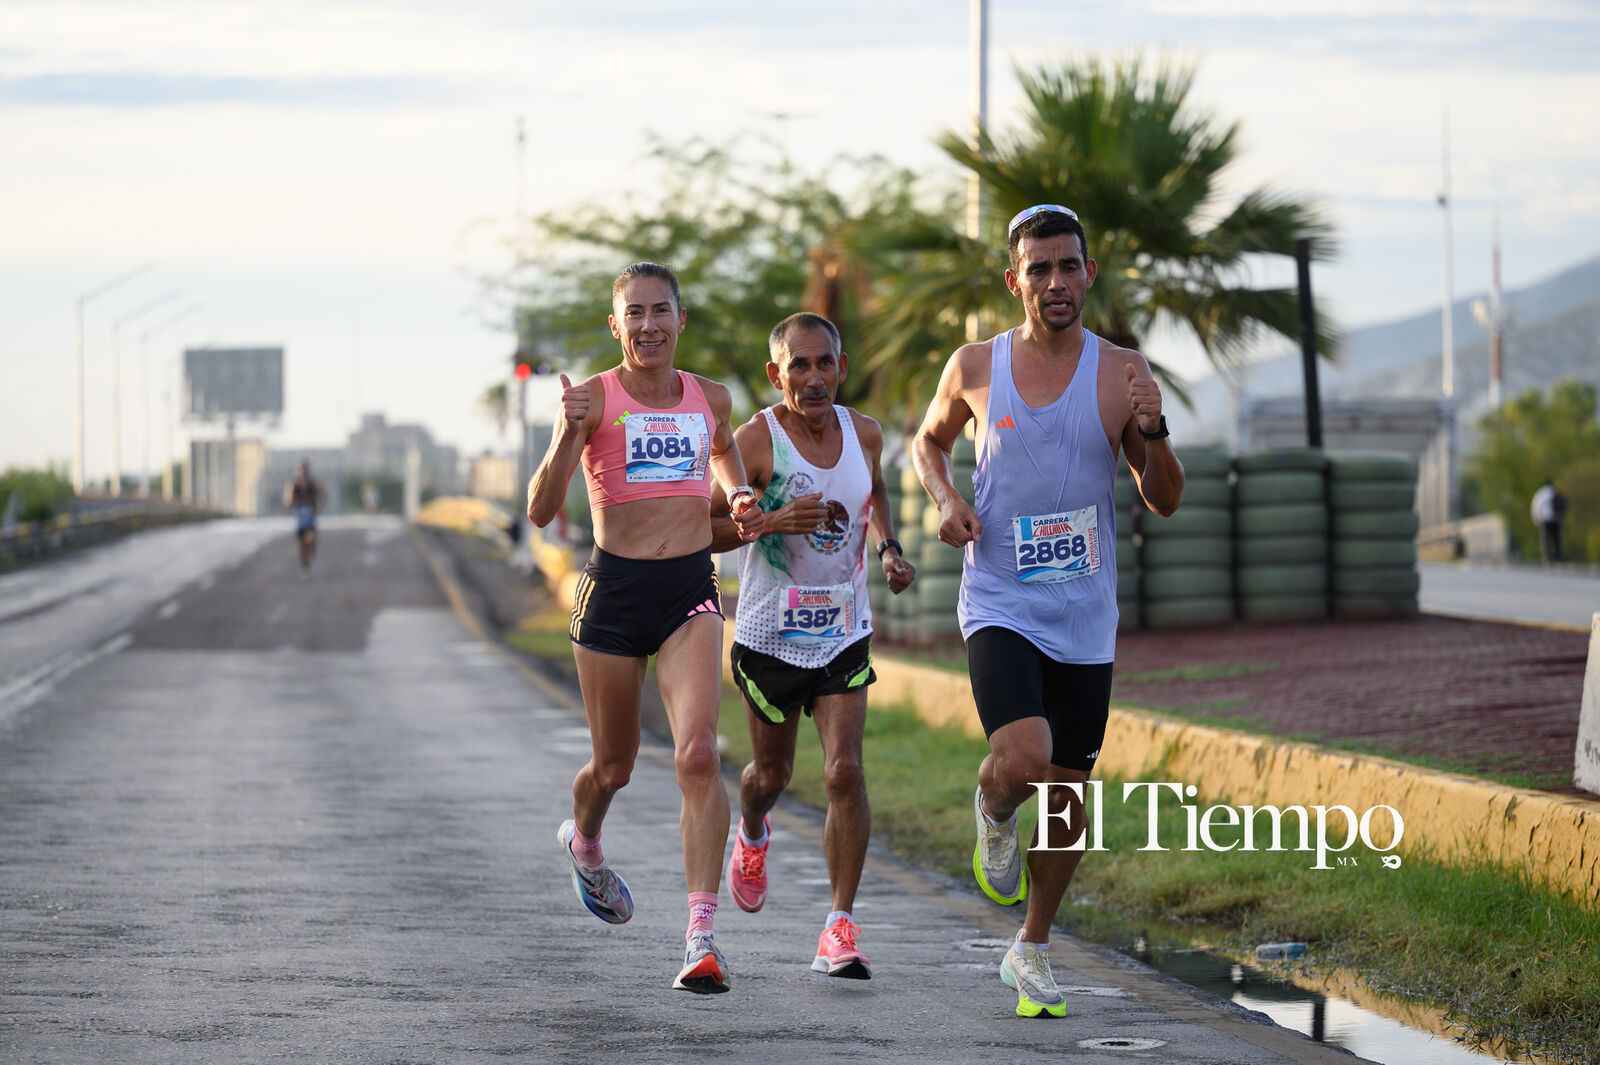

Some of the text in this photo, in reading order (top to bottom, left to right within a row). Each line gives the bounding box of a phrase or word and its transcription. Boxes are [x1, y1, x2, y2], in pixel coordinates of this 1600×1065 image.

[631, 436, 696, 460] 1081
[1033, 516, 1069, 527] CARRERA
[1018, 534, 1087, 566] 2868
[783, 607, 841, 629] 1387
